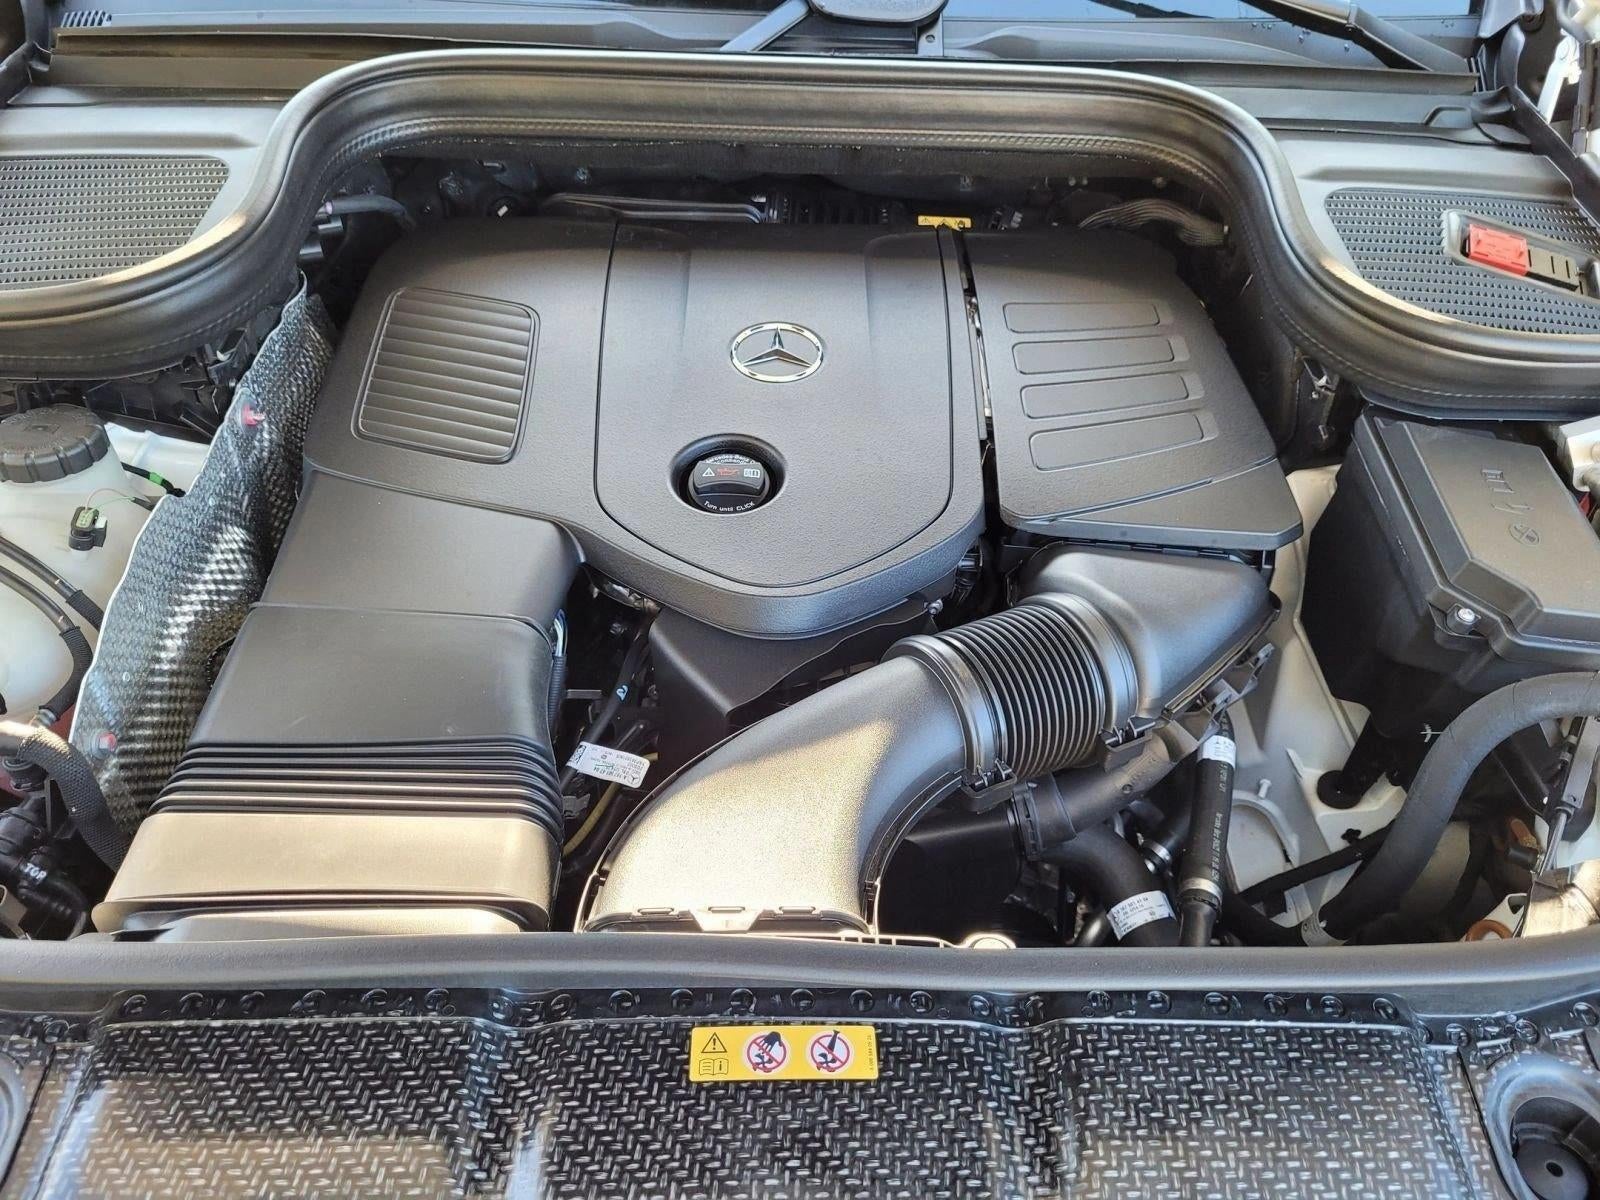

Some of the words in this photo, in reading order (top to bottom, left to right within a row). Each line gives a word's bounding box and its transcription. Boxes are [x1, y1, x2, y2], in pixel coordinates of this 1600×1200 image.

[704, 500, 718, 510] Turn
[736, 501, 756, 511] CLICK
[24, 863, 47, 880] TOP
